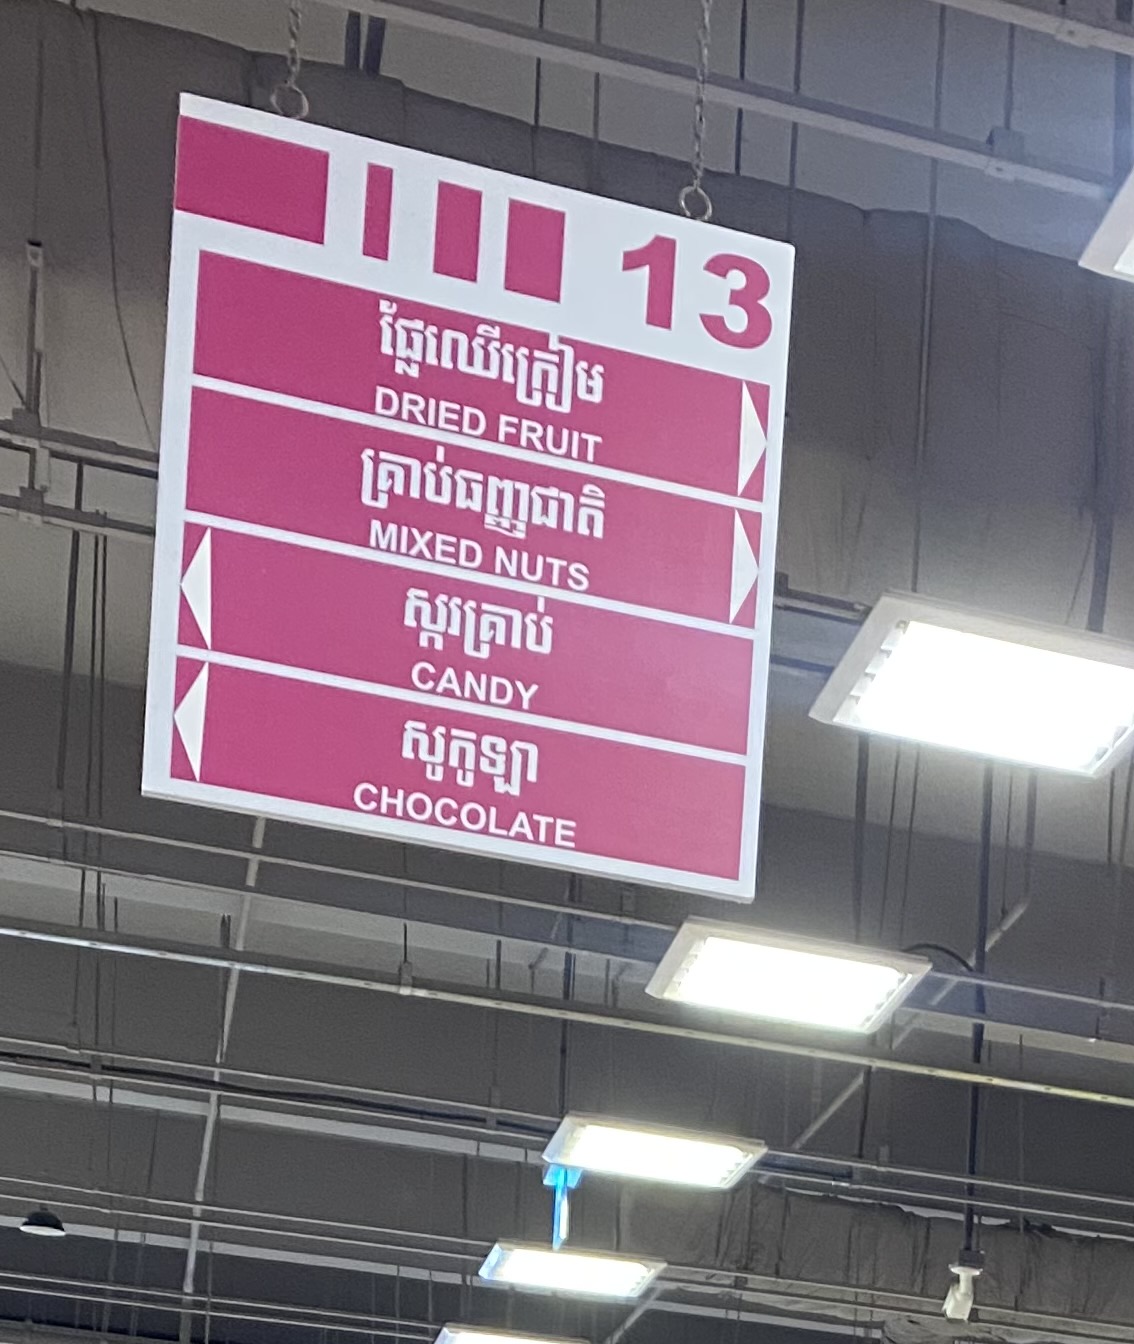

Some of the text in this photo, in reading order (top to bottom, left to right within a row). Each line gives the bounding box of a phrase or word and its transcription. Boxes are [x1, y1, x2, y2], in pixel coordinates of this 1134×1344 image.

[621, 233, 774, 350] 13
[375, 385, 603, 463] DRIED FRUIT
[369, 519, 590, 592] MIXED NUTS
[411, 661, 539, 709] CANDY
[353, 782, 577, 848] CHOCOLATE
